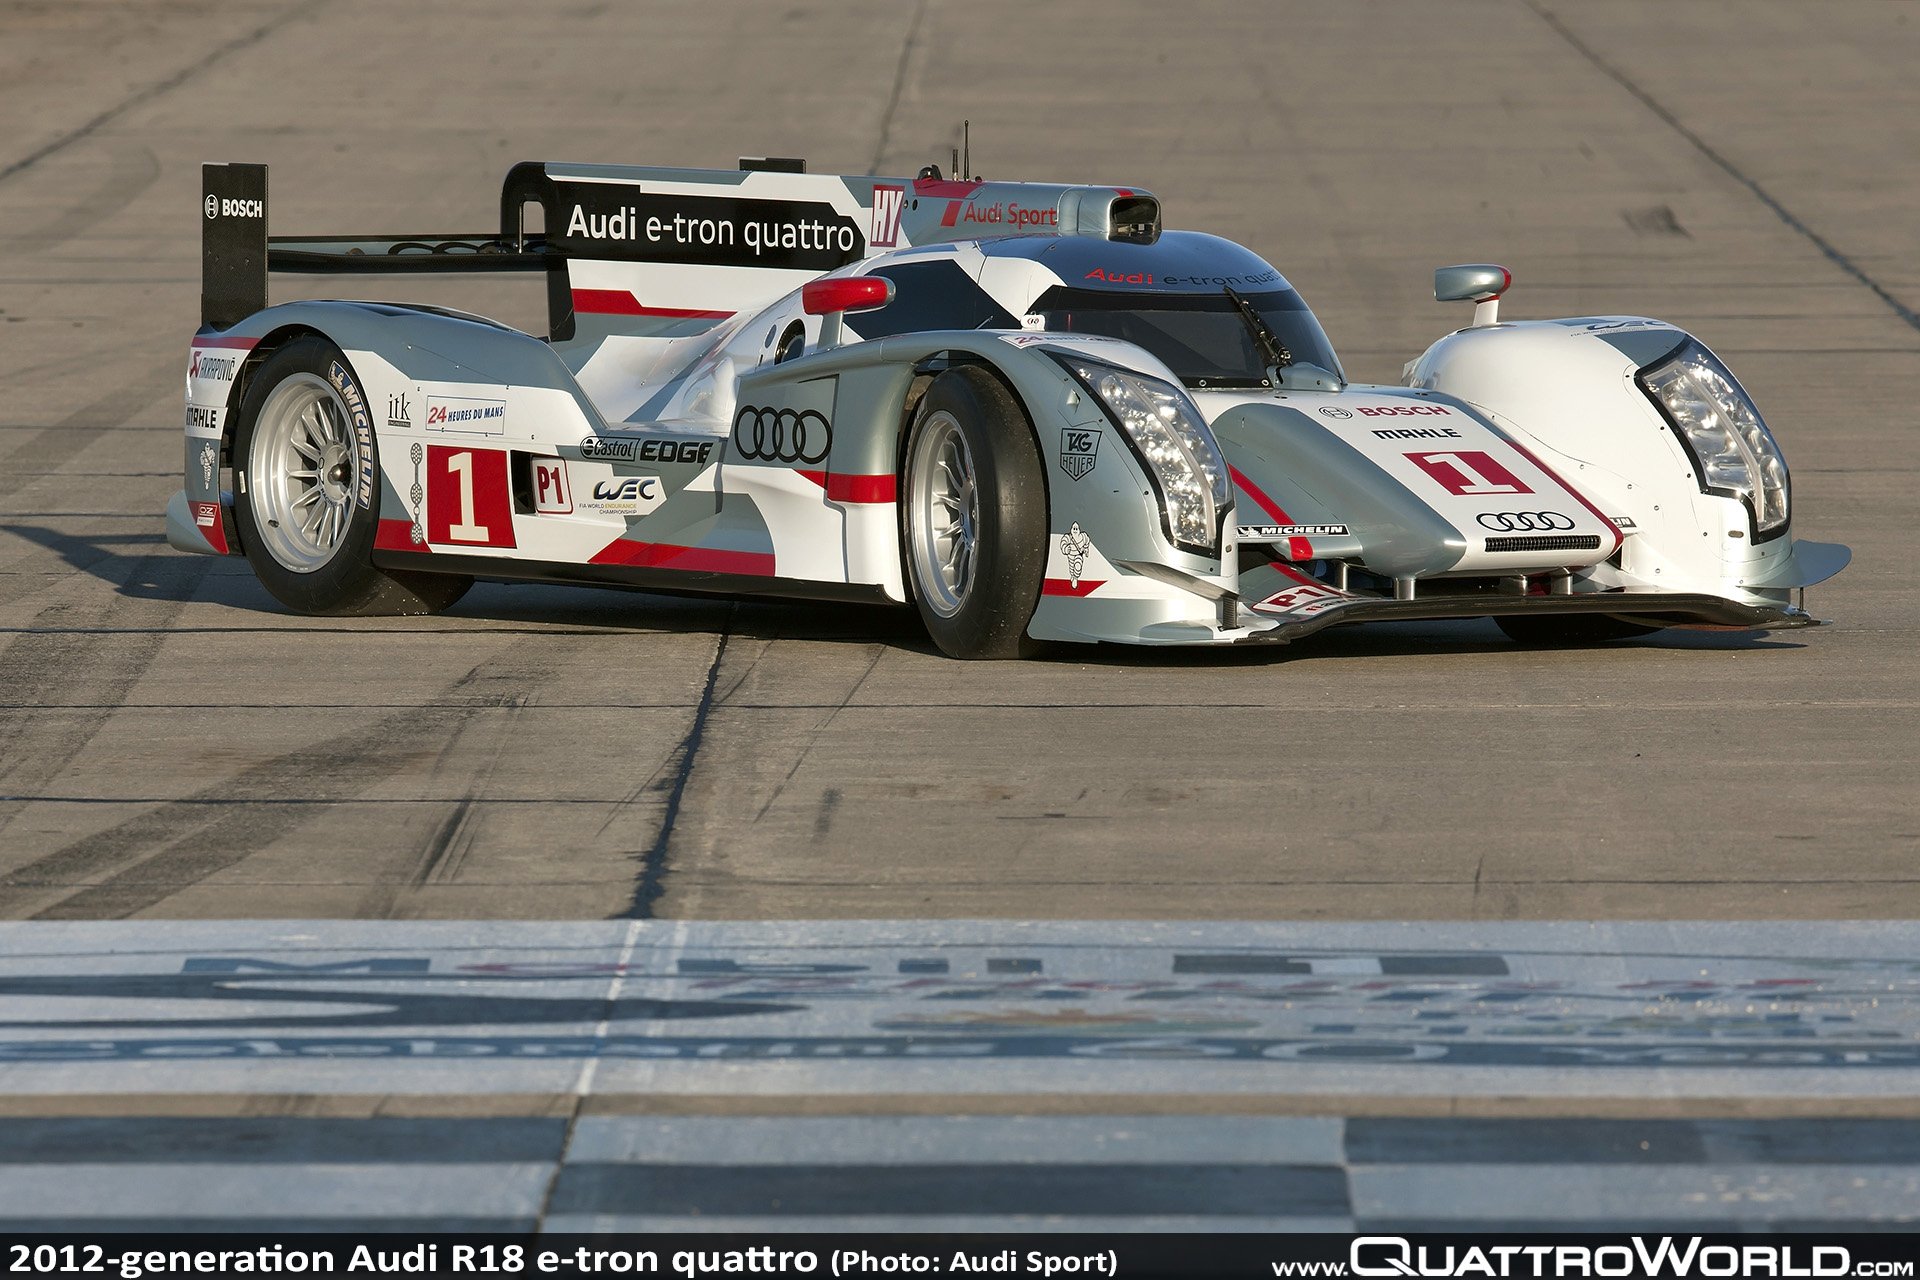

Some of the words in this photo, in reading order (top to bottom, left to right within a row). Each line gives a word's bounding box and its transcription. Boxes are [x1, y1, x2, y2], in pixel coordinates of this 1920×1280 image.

[222, 198, 263, 218] BOSCH
[871, 189, 904, 243] HY
[963, 201, 1003, 223] Audi
[1007, 202, 1059, 230] Sport
[567, 204, 636, 240] Audi
[646, 212, 734, 245] e-tron
[744, 218, 854, 255] quattro
[1084, 267, 1154, 285] Audi
[1163, 273, 1243, 286] e-tron
[388, 391, 411, 420] itk
[427, 405, 447, 424] 24
[448, 408, 473, 422] HEURES
[474, 408, 484, 420] DU
[485, 405, 504, 419] MANS
[1356, 405, 1451, 417] BOSCH
[186, 407, 218, 428] MAHLE
[1067, 432, 1093, 452] TAG
[1372, 427, 1462, 440] MAHLE
[342, 383, 372, 507] MICHELIN
[594, 438, 633, 457] Castrol
[1062, 456, 1093, 477] HEUER
[1423, 452, 1519, 493] 1
[537, 464, 565, 505] P1
[592, 478, 656, 501] WEC
[448, 451, 489, 542] 1
[199, 506, 214, 515] OZ
[1261, 526, 1343, 535] MICHELIN
[1267, 588, 1326, 607] P1
